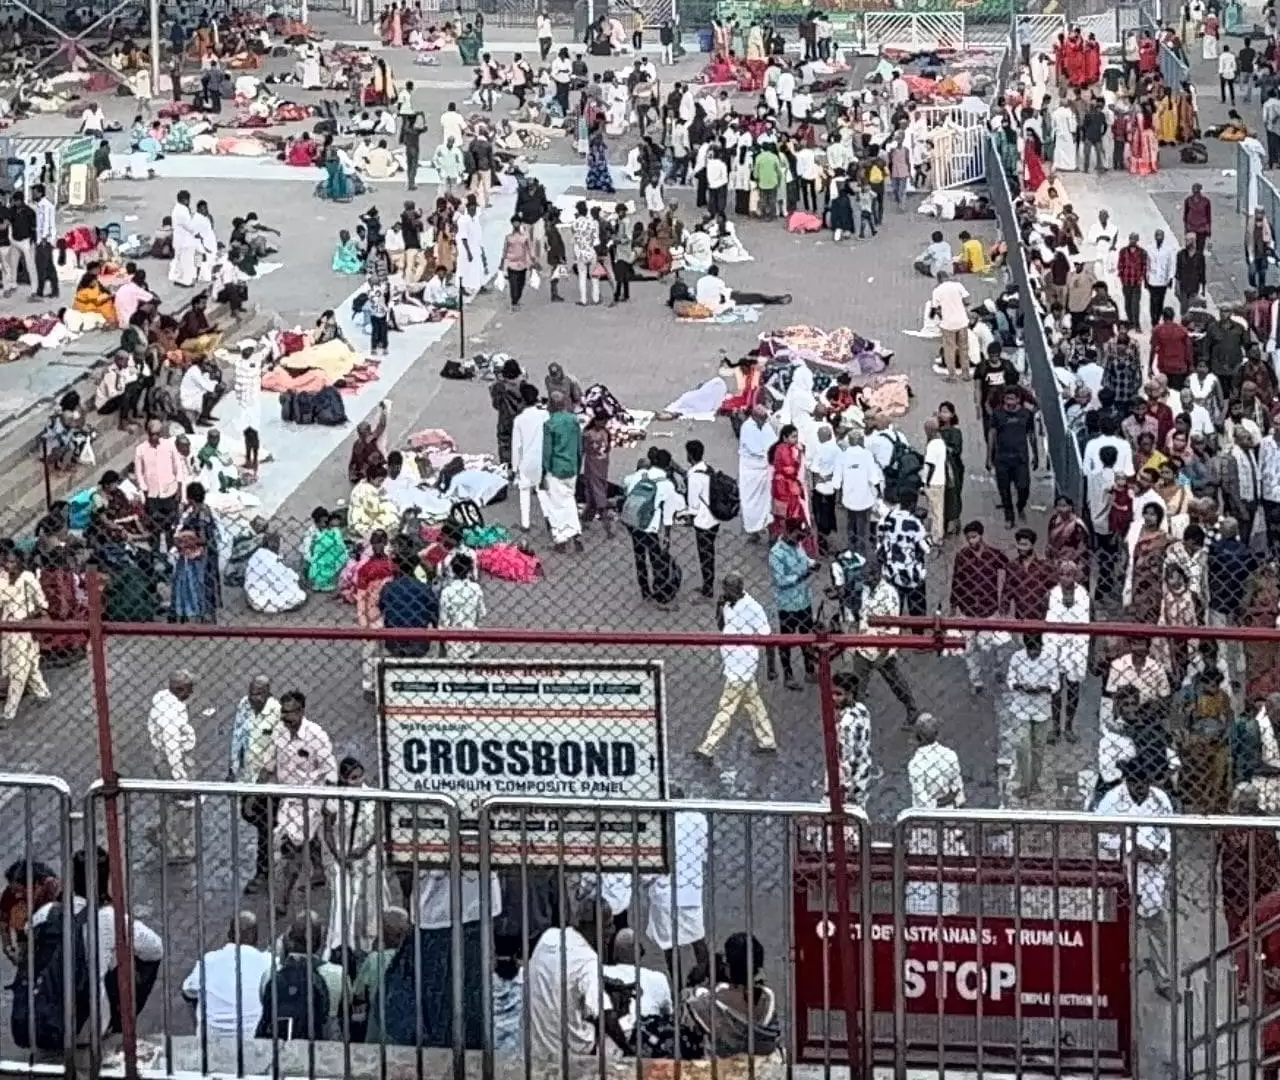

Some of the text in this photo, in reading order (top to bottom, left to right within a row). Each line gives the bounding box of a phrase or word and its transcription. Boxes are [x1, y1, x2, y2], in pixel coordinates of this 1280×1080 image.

[402, 737, 635, 777] CROSSBOND
[496, 779, 576, 793] COMPOSITE
[581, 780, 627, 793] PANEL
[903, 957, 1016, 1001] STOP
